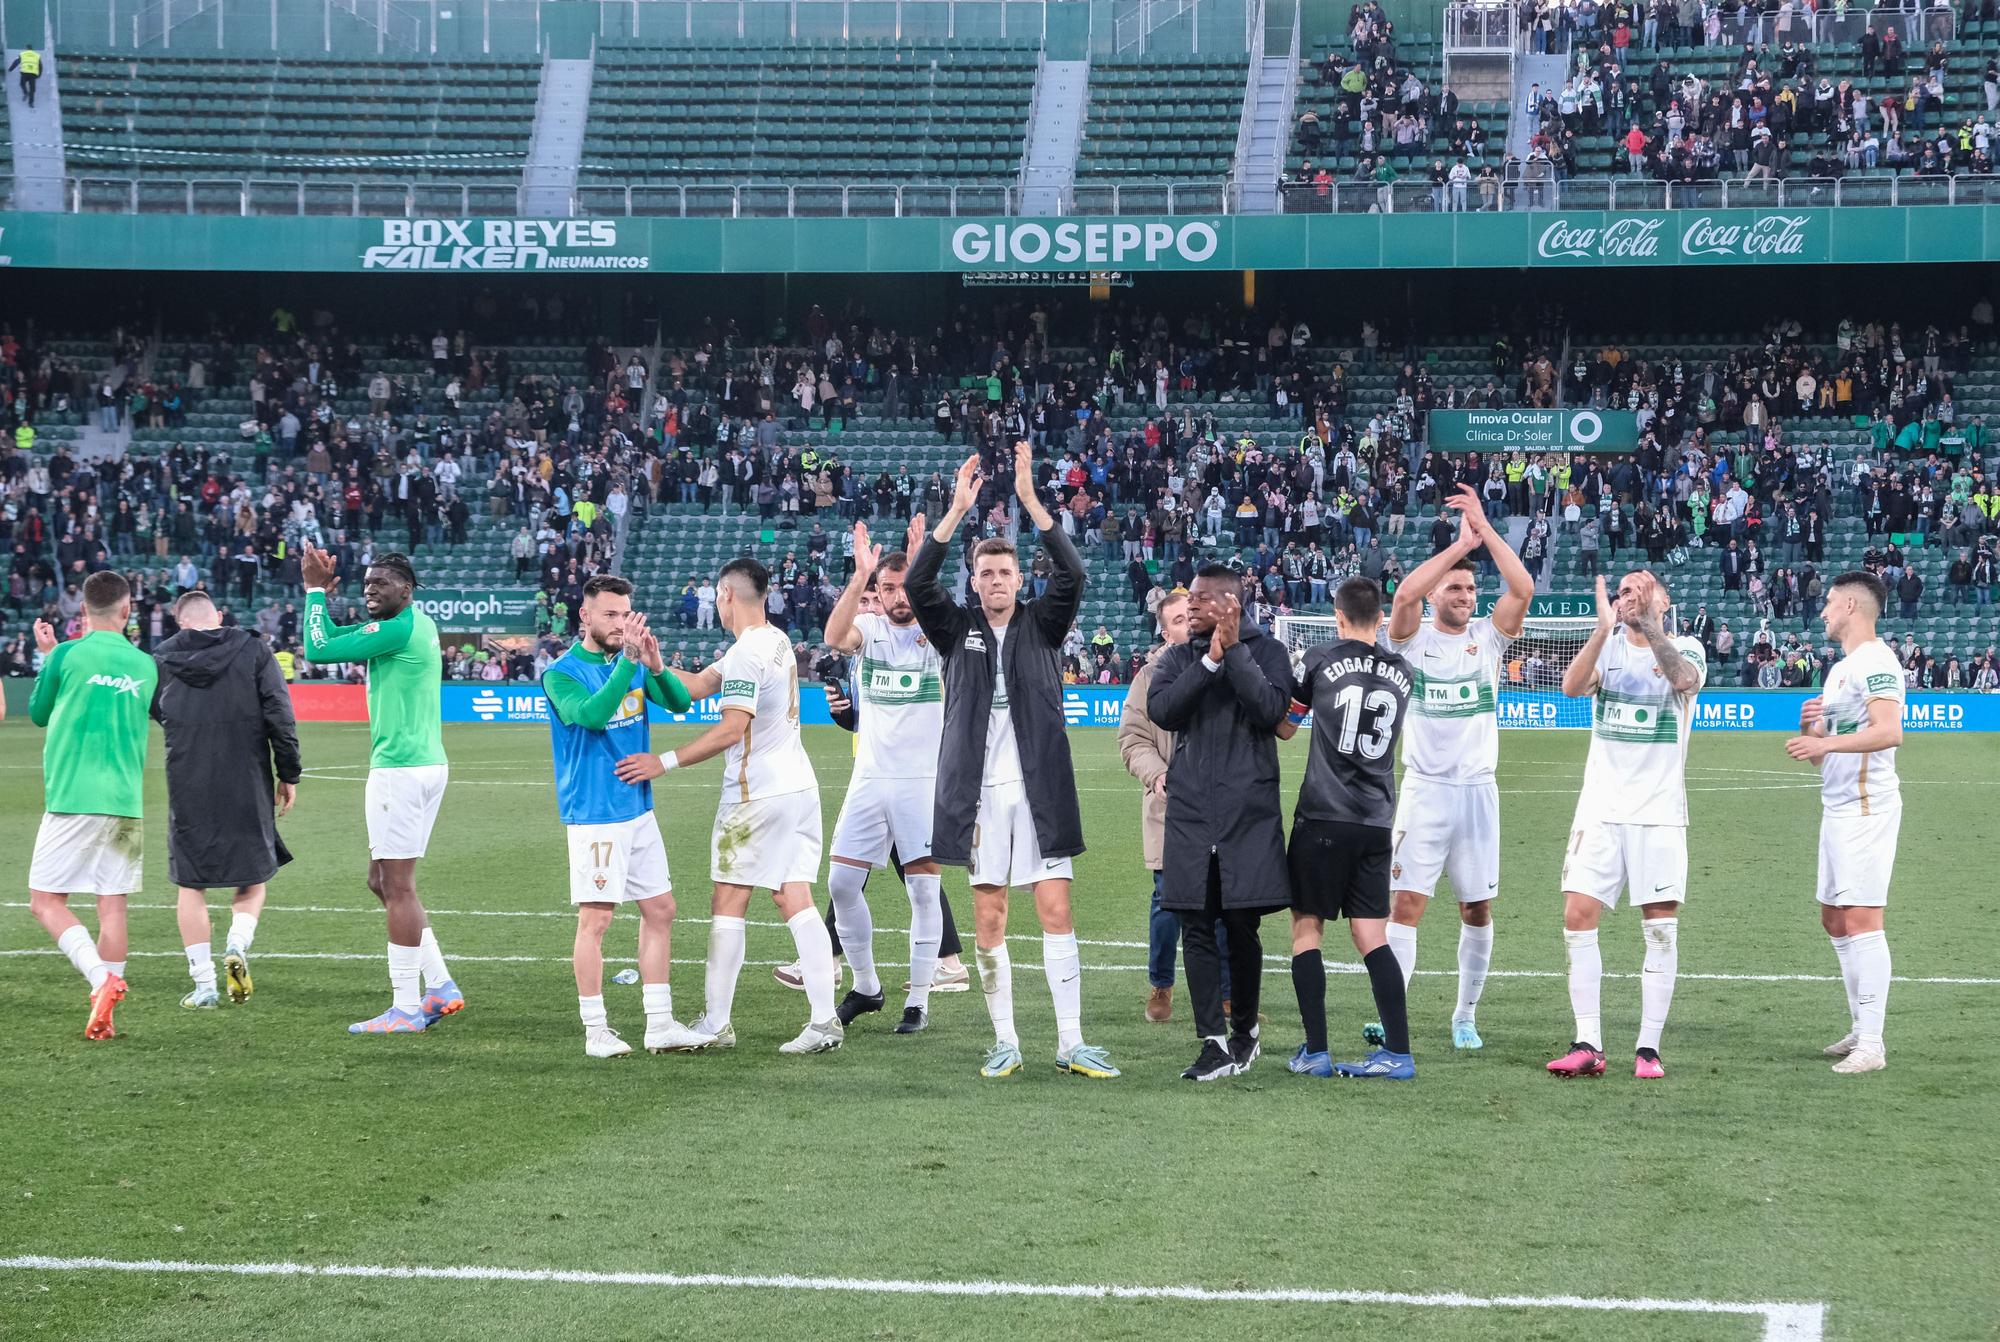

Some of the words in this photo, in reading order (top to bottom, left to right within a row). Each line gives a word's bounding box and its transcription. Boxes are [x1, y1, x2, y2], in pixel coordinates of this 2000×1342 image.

[383, 219, 473, 247] BOX
[483, 220, 617, 247] REYES
[952, 221, 1218, 263] GIOSEPPO
[359, 246, 549, 269] FALKEN
[548, 256, 649, 269] NEUMATICOS
[1468, 412, 1509, 424] Innova
[1512, 411, 1553, 424] Ocular
[1465, 429, 1504, 442] Clínica
[875, 674, 890, 687] TM
[1323, 656, 1374, 683] EDGAR
[1376, 661, 1411, 698] BADIA
[86, 674, 148, 698] AMIX
[1428, 689, 1448, 700] TM
[1094, 700, 1126, 716] IM
[1498, 702, 1557, 719] IMED
[1607, 707, 1621, 720] TM
[1695, 703, 1755, 720] IMED
[1903, 704, 1964, 721] IMED
[1334, 684, 1398, 760] 13
[1498, 719, 1557, 727] HOSPITALES
[1695, 720, 1754, 728] HOSPITALES
[1903, 721, 1963, 729] HOSPITALES
[591, 841, 613, 868] 17
